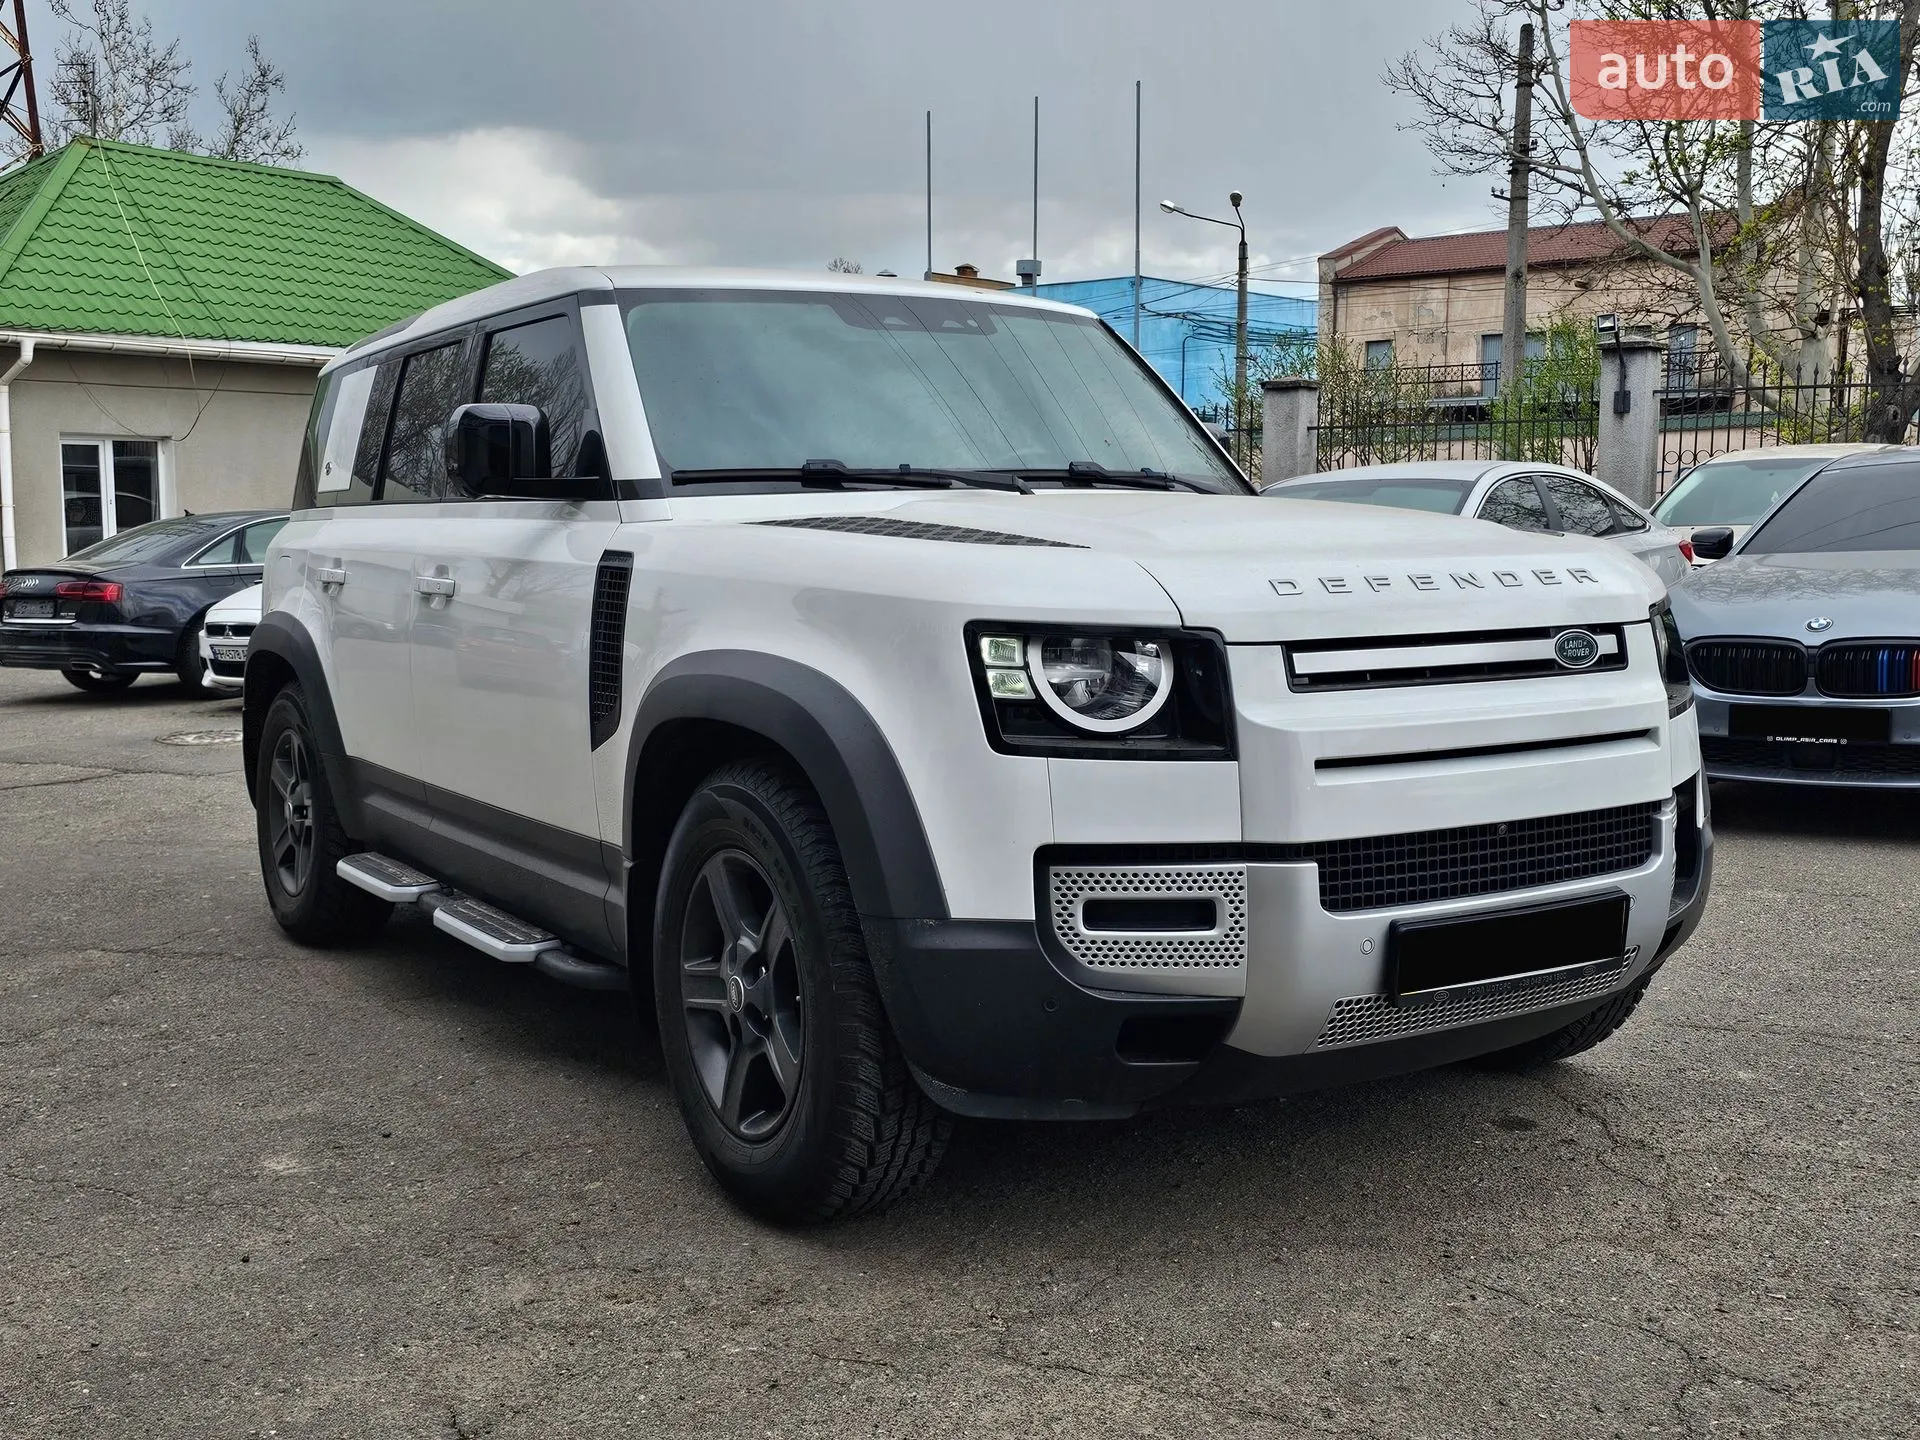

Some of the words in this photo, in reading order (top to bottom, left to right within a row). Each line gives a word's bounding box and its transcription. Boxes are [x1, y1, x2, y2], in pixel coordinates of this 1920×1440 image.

[1268, 567, 1599, 596] DEFENDER
[1564, 640, 1582, 649] LAND
[1567, 648, 1590, 657] ROVER
